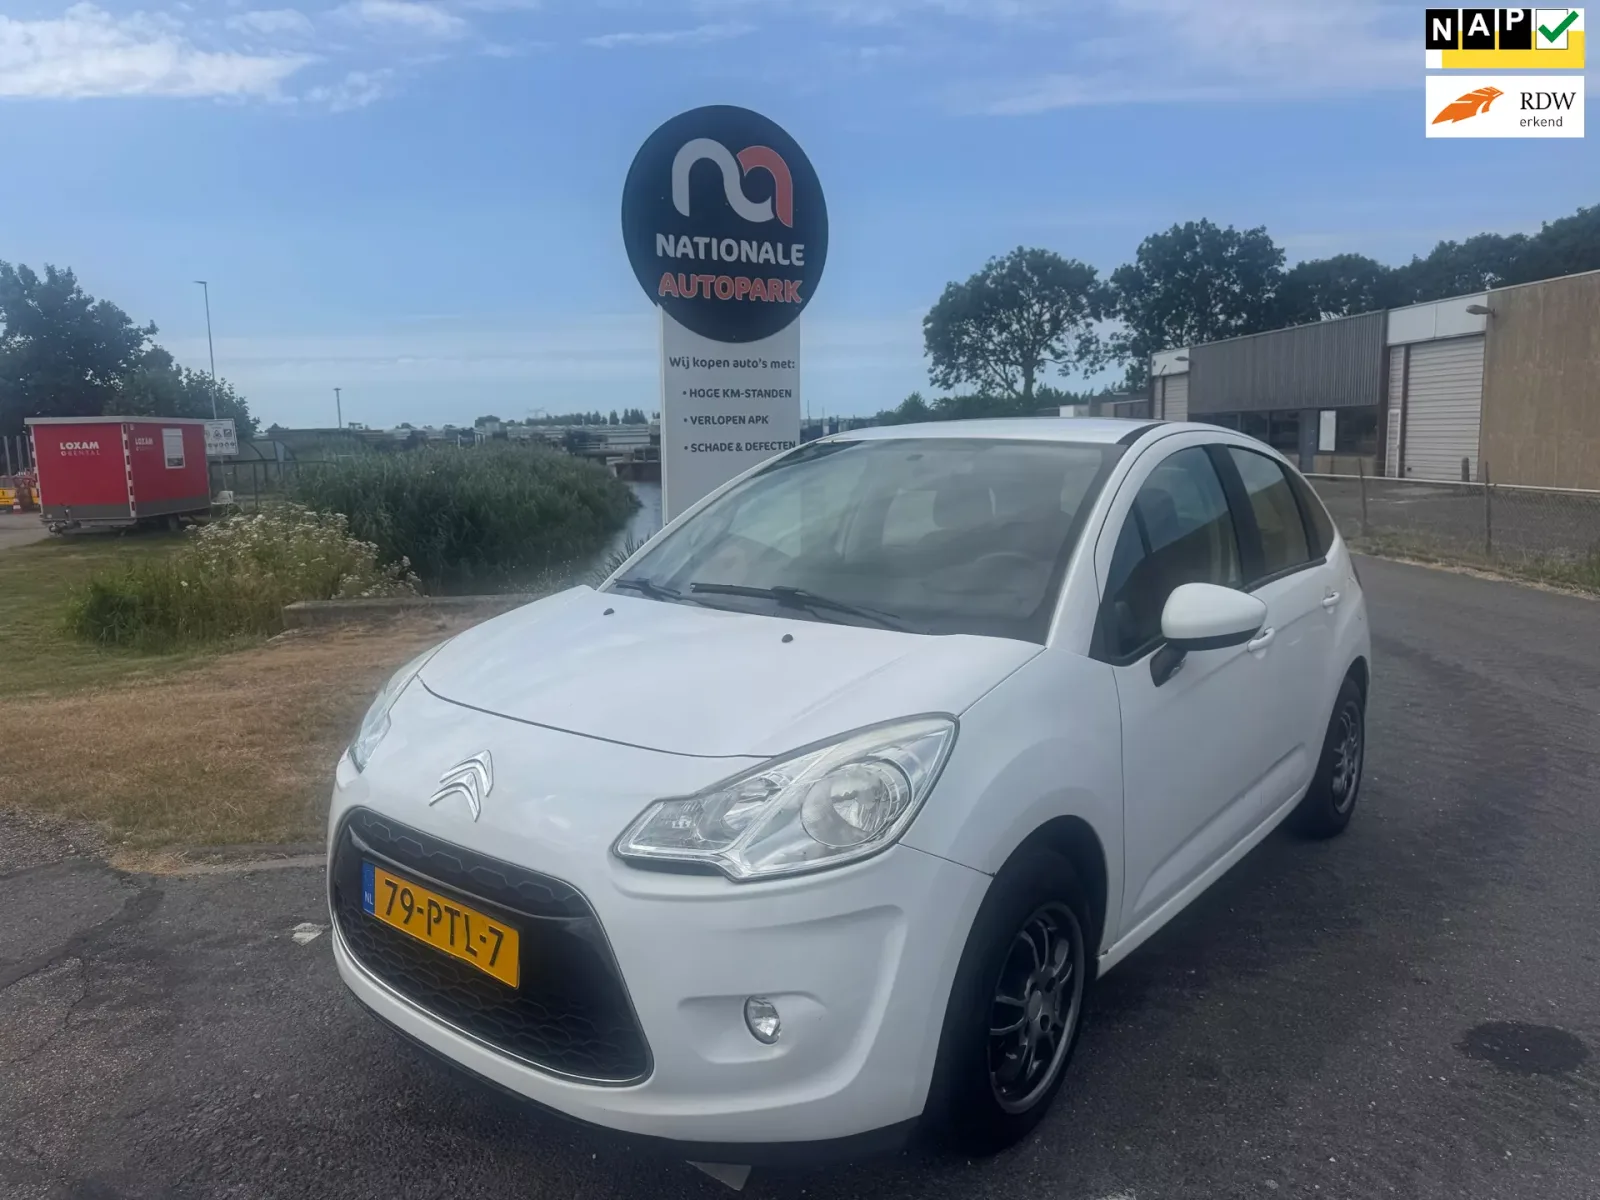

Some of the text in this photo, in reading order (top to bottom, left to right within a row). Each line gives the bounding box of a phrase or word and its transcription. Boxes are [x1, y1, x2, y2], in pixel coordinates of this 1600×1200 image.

[656, 233, 805, 266] NATIONALE
[658, 272, 802, 303] AUTOPARK
[669, 356, 796, 369] Wij kopen auto's met:
[689, 388, 792, 398] HOGE KM-STANDEN
[690, 415, 769, 425] VERLOPEN APK
[60, 441, 100, 450] LOXAM
[690, 441, 796, 452] SCHADE & DEFECTEN
[364, 890, 374, 906] NL
[384, 876, 504, 968] 79-PTL-7
